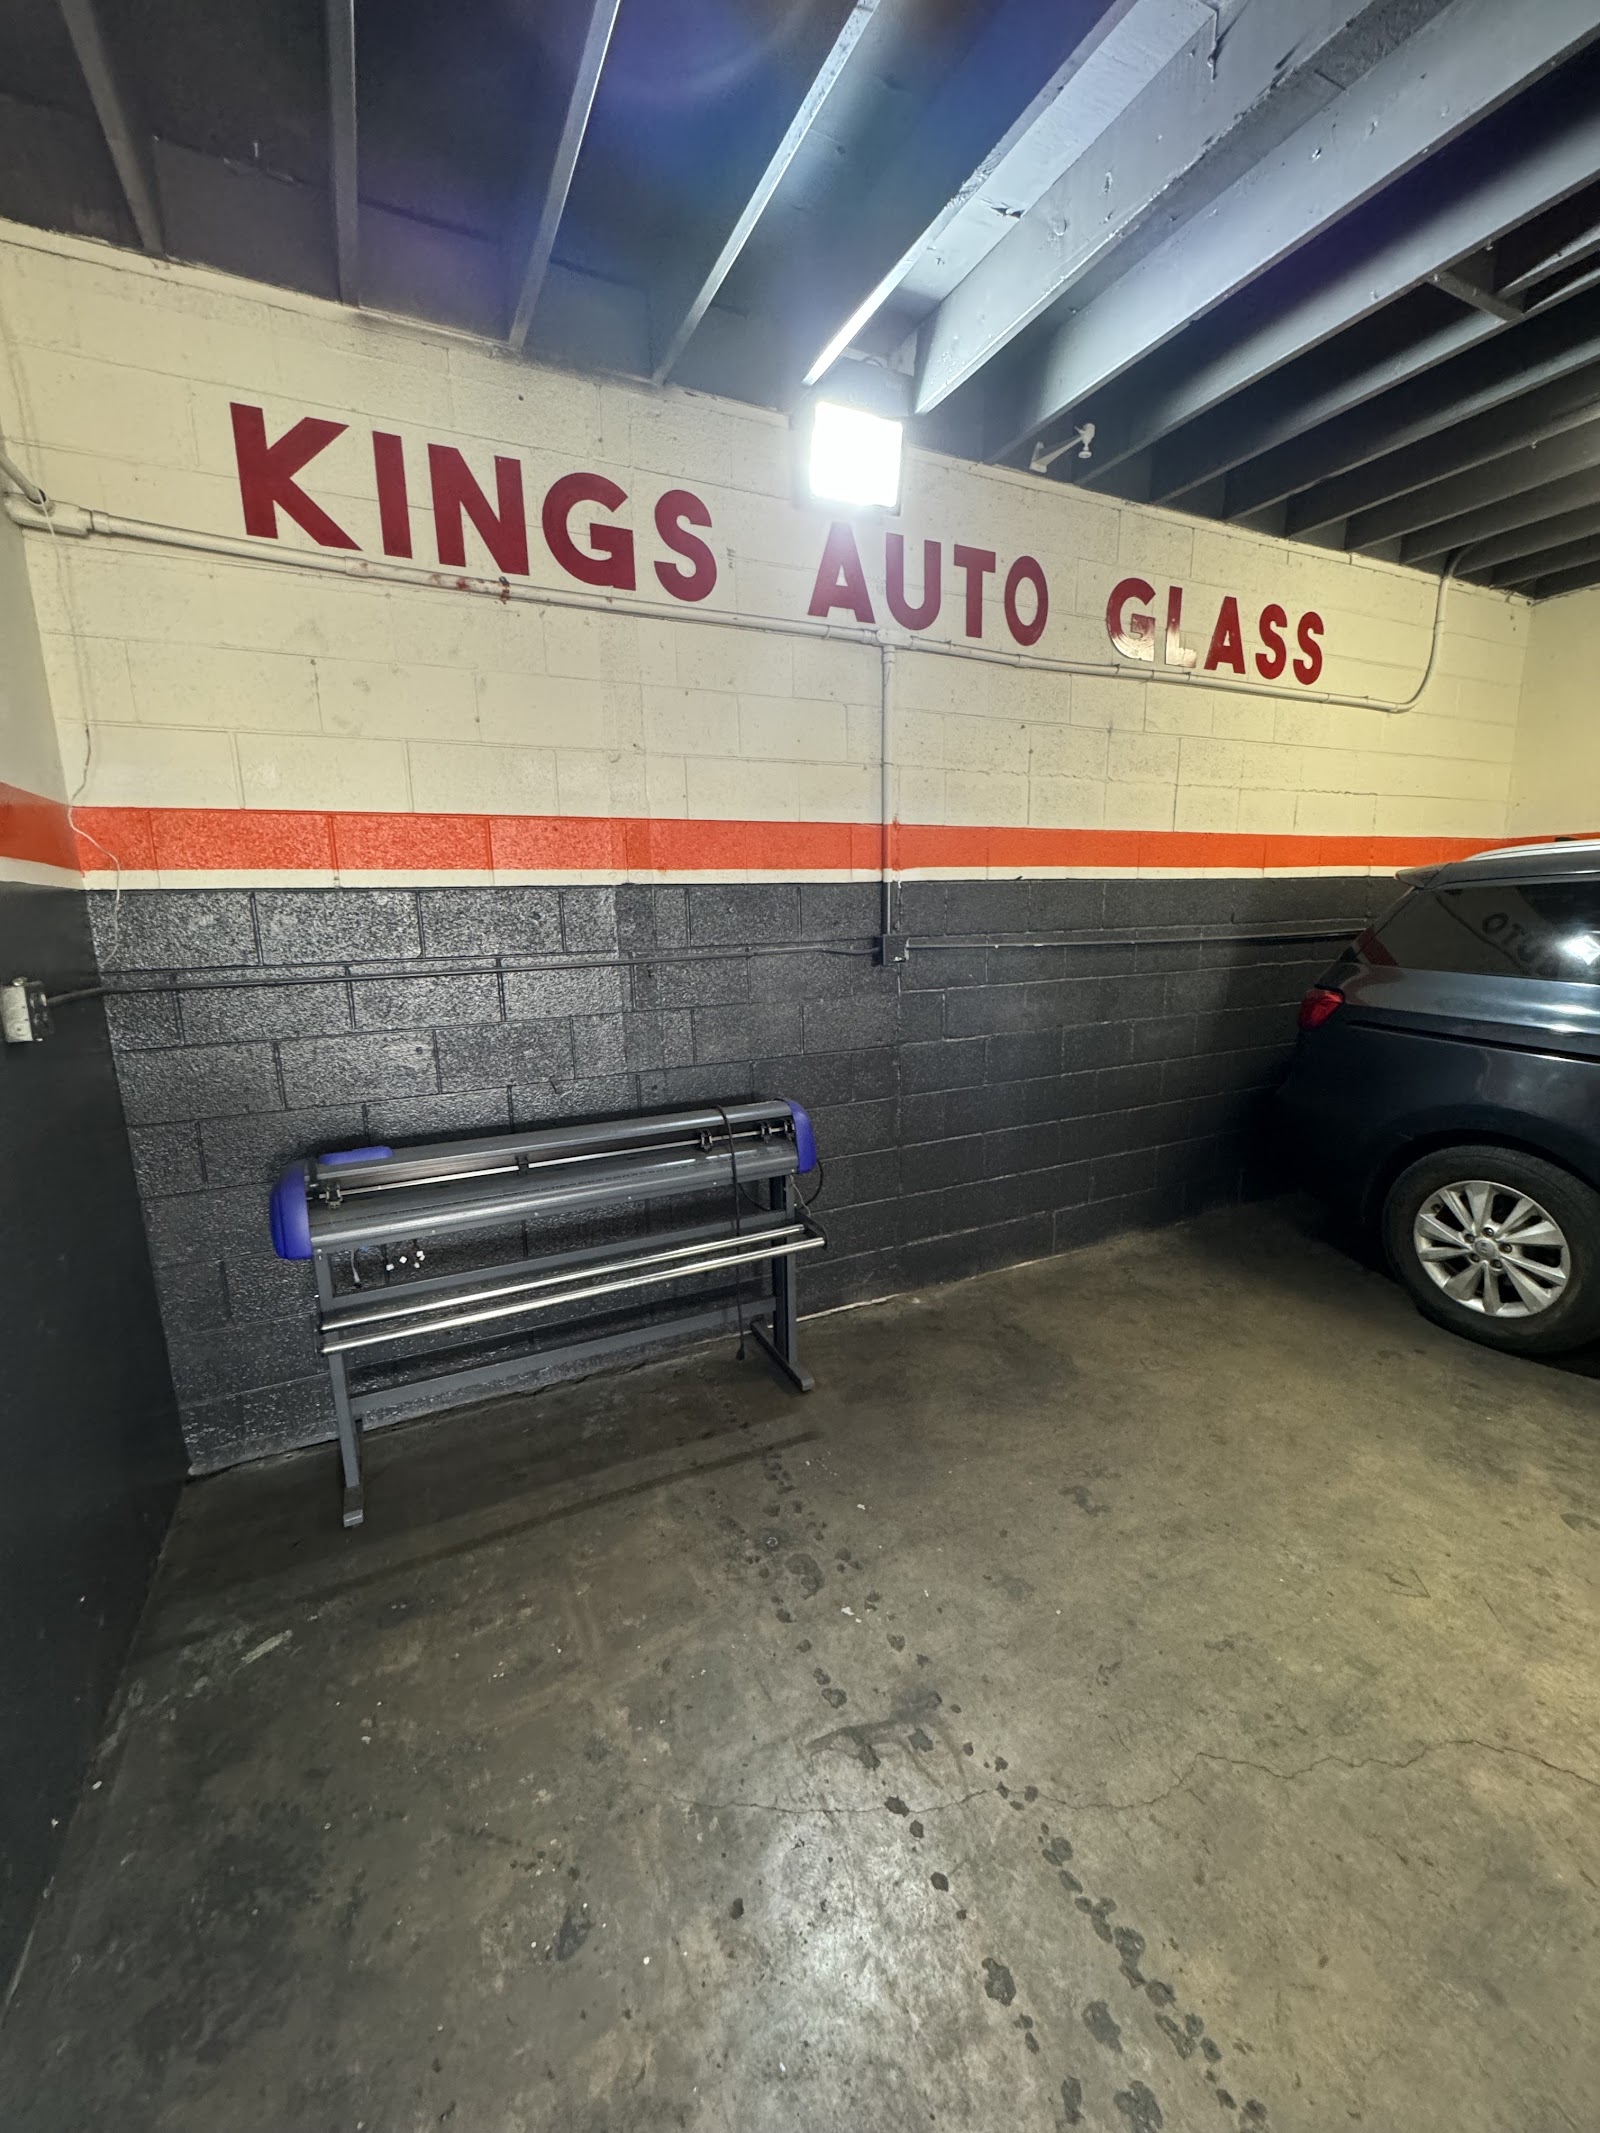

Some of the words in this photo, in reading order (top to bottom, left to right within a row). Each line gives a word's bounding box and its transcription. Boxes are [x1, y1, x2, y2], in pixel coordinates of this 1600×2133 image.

[230, 401, 717, 602] KINGS
[807, 521, 1049, 647] AUTO
[1106, 577, 1325, 686] GLASS
